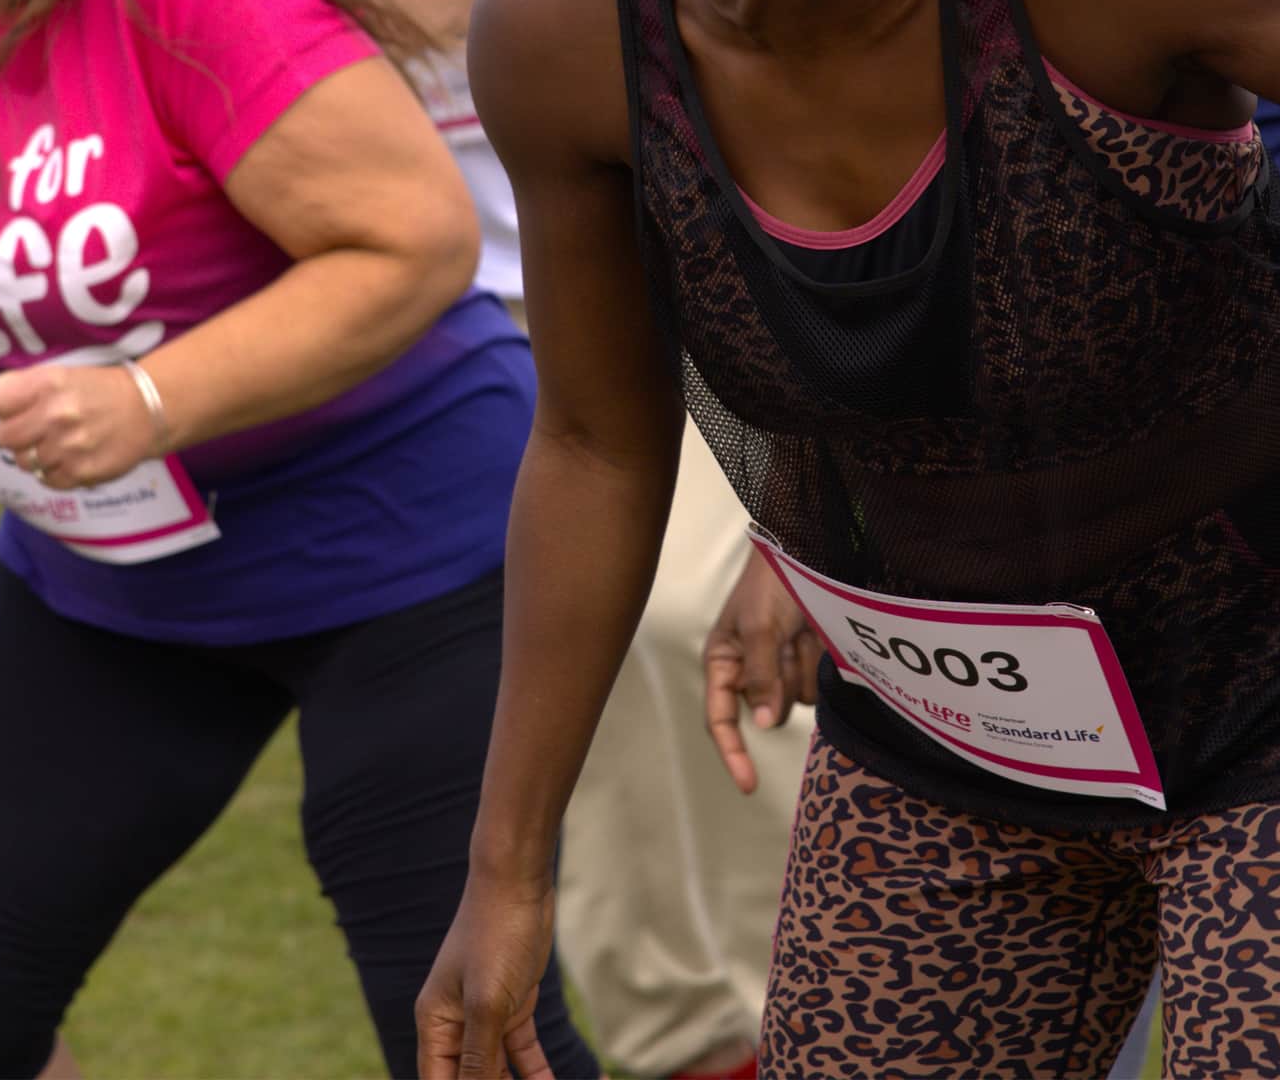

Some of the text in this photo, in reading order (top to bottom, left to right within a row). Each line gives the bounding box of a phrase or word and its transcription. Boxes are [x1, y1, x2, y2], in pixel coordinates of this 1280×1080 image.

[8, 123, 104, 211] for
[844, 615, 1028, 693] 5003
[922, 697, 972, 727] Life
[981, 721, 1063, 742] Standard
[1064, 729, 1100, 743] Life
